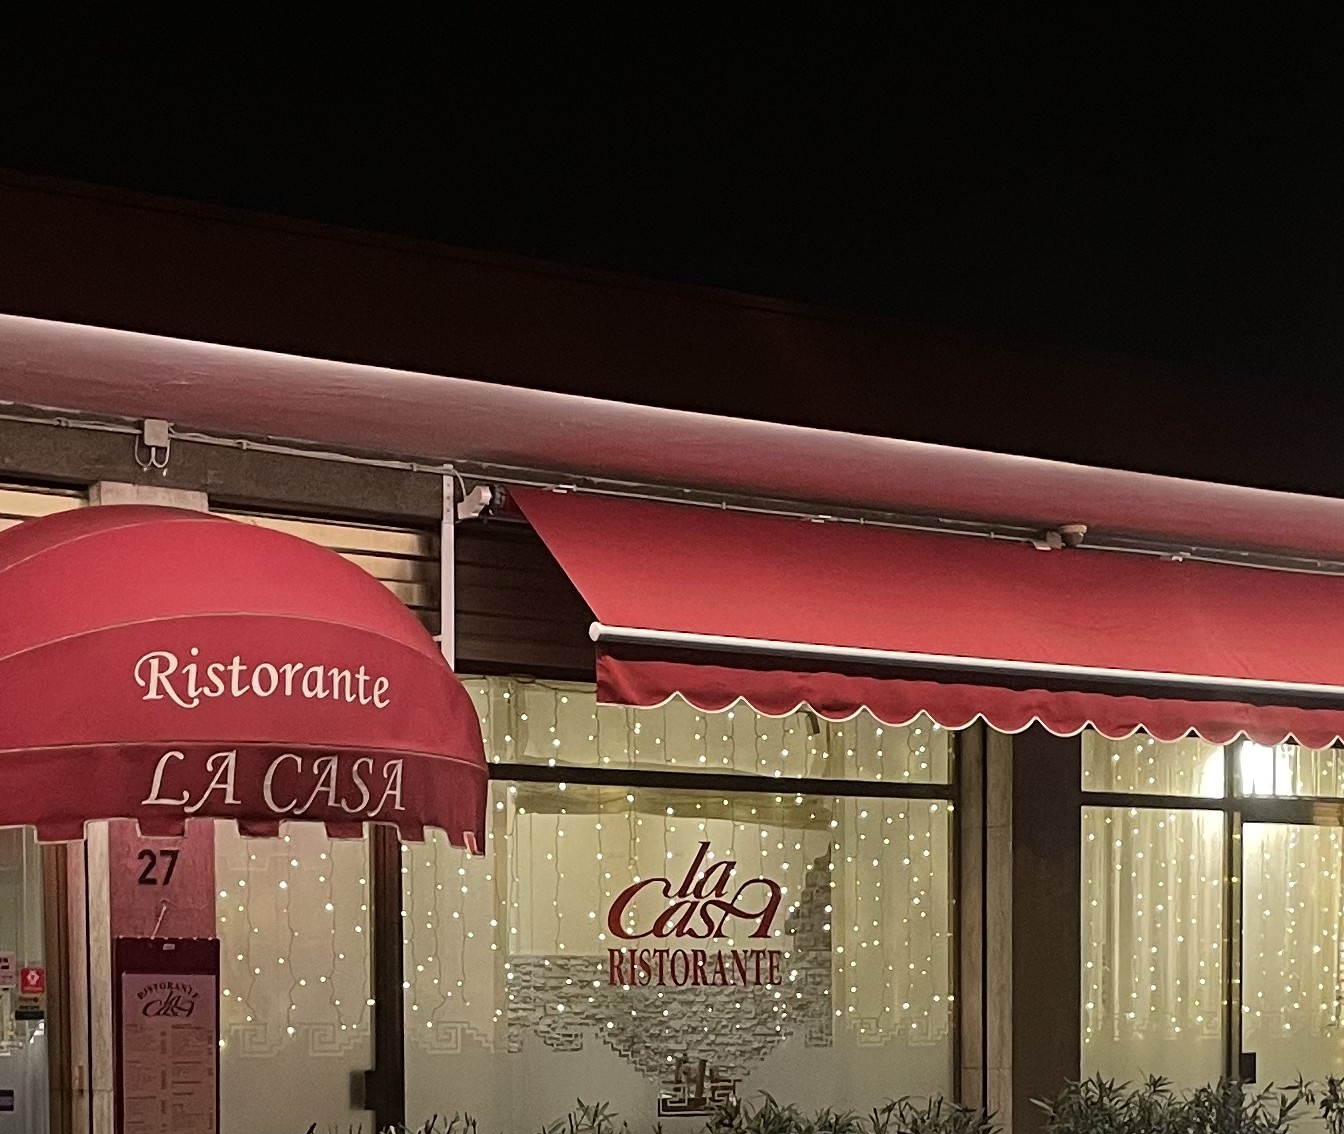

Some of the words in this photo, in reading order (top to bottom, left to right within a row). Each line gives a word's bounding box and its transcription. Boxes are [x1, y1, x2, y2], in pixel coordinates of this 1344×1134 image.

[134, 647, 391, 709] Ristorante
[141, 750, 242, 813] LA
[263, 753, 406, 817] CASA
[137, 849, 180, 887] 27
[607, 948, 783, 987] RISTORANTE
